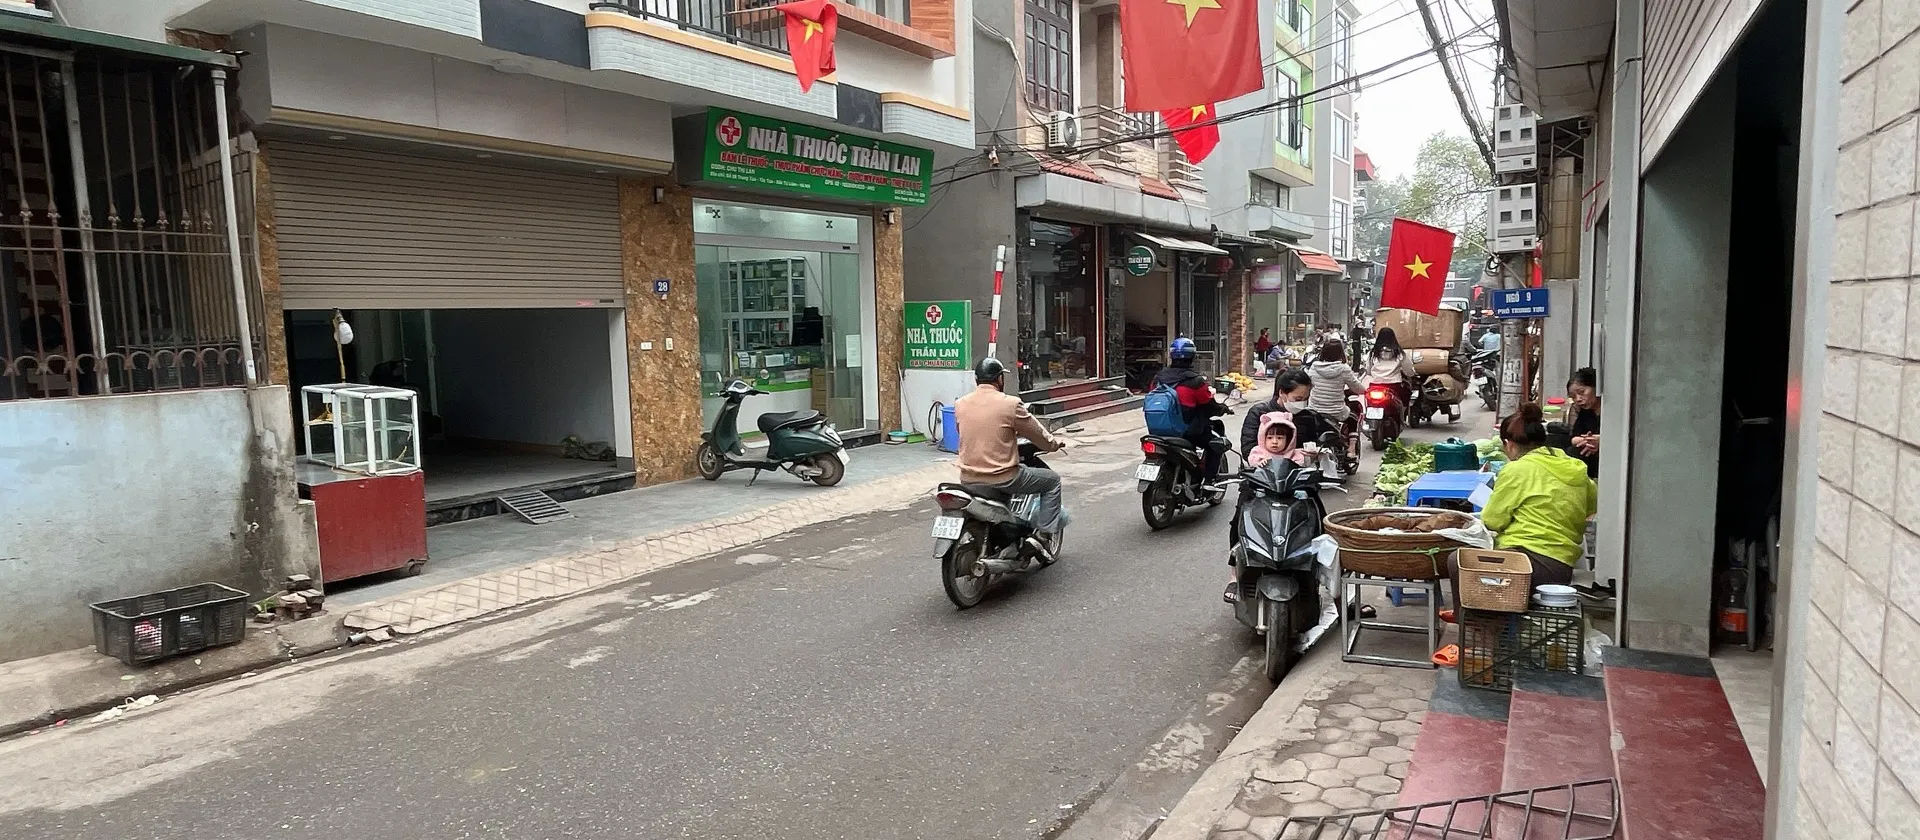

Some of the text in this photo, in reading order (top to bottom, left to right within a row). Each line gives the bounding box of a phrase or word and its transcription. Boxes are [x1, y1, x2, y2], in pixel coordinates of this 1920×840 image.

[747, 126, 920, 176] NHÀ THUỐC TRẦN LAN
[657, 281, 668, 291] 28
[1526, 291, 1531, 302] 9
[906, 320, 963, 344] NHÀ THUỐC
[910, 345, 960, 358] TRẦN LAN
